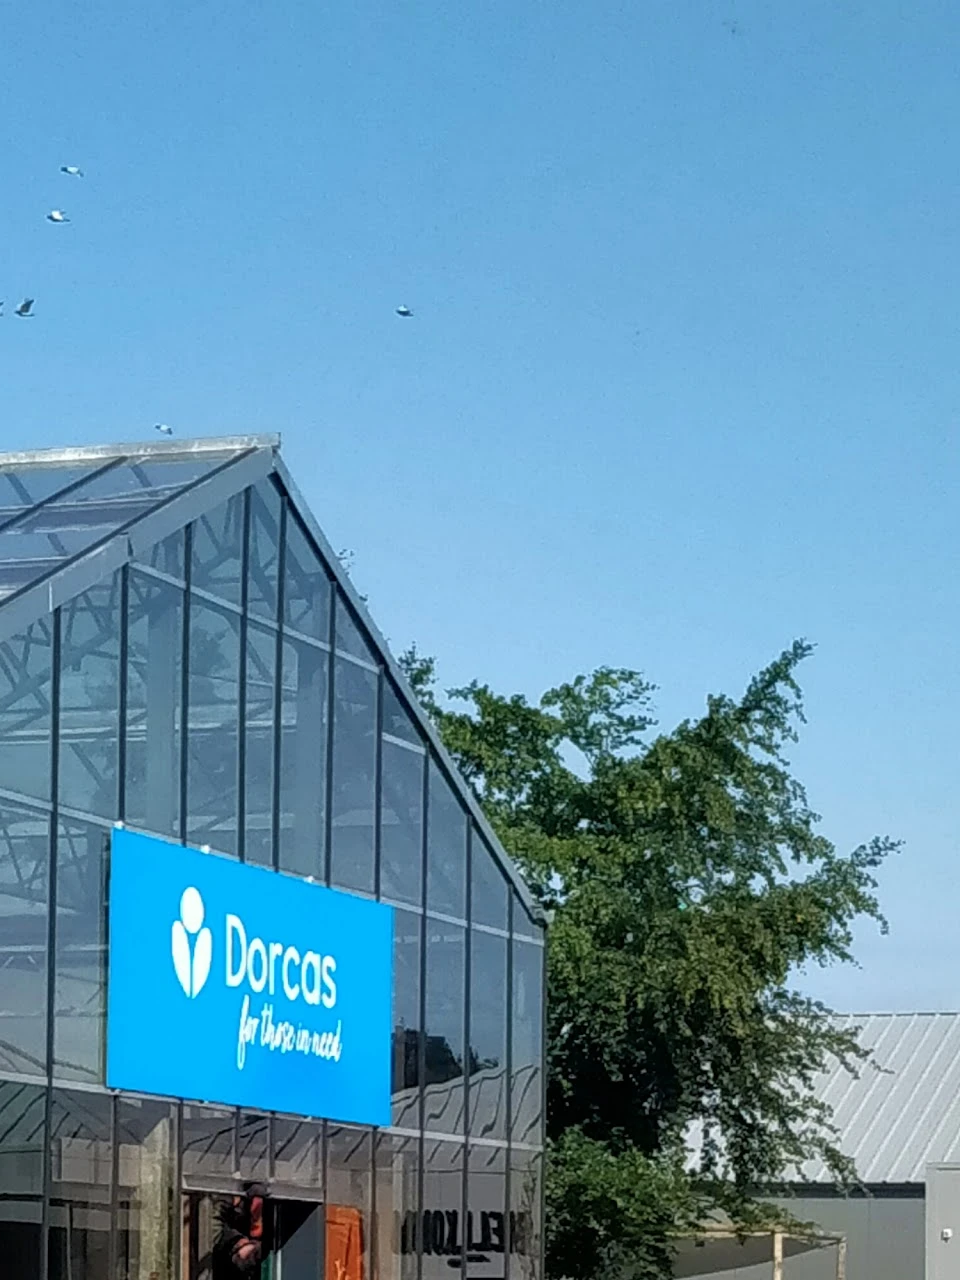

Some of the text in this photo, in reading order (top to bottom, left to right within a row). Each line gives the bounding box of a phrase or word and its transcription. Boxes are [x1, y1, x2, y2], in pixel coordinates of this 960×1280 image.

[225, 913, 337, 1009] Dorcas
[237, 994, 342, 1070] for those in need
